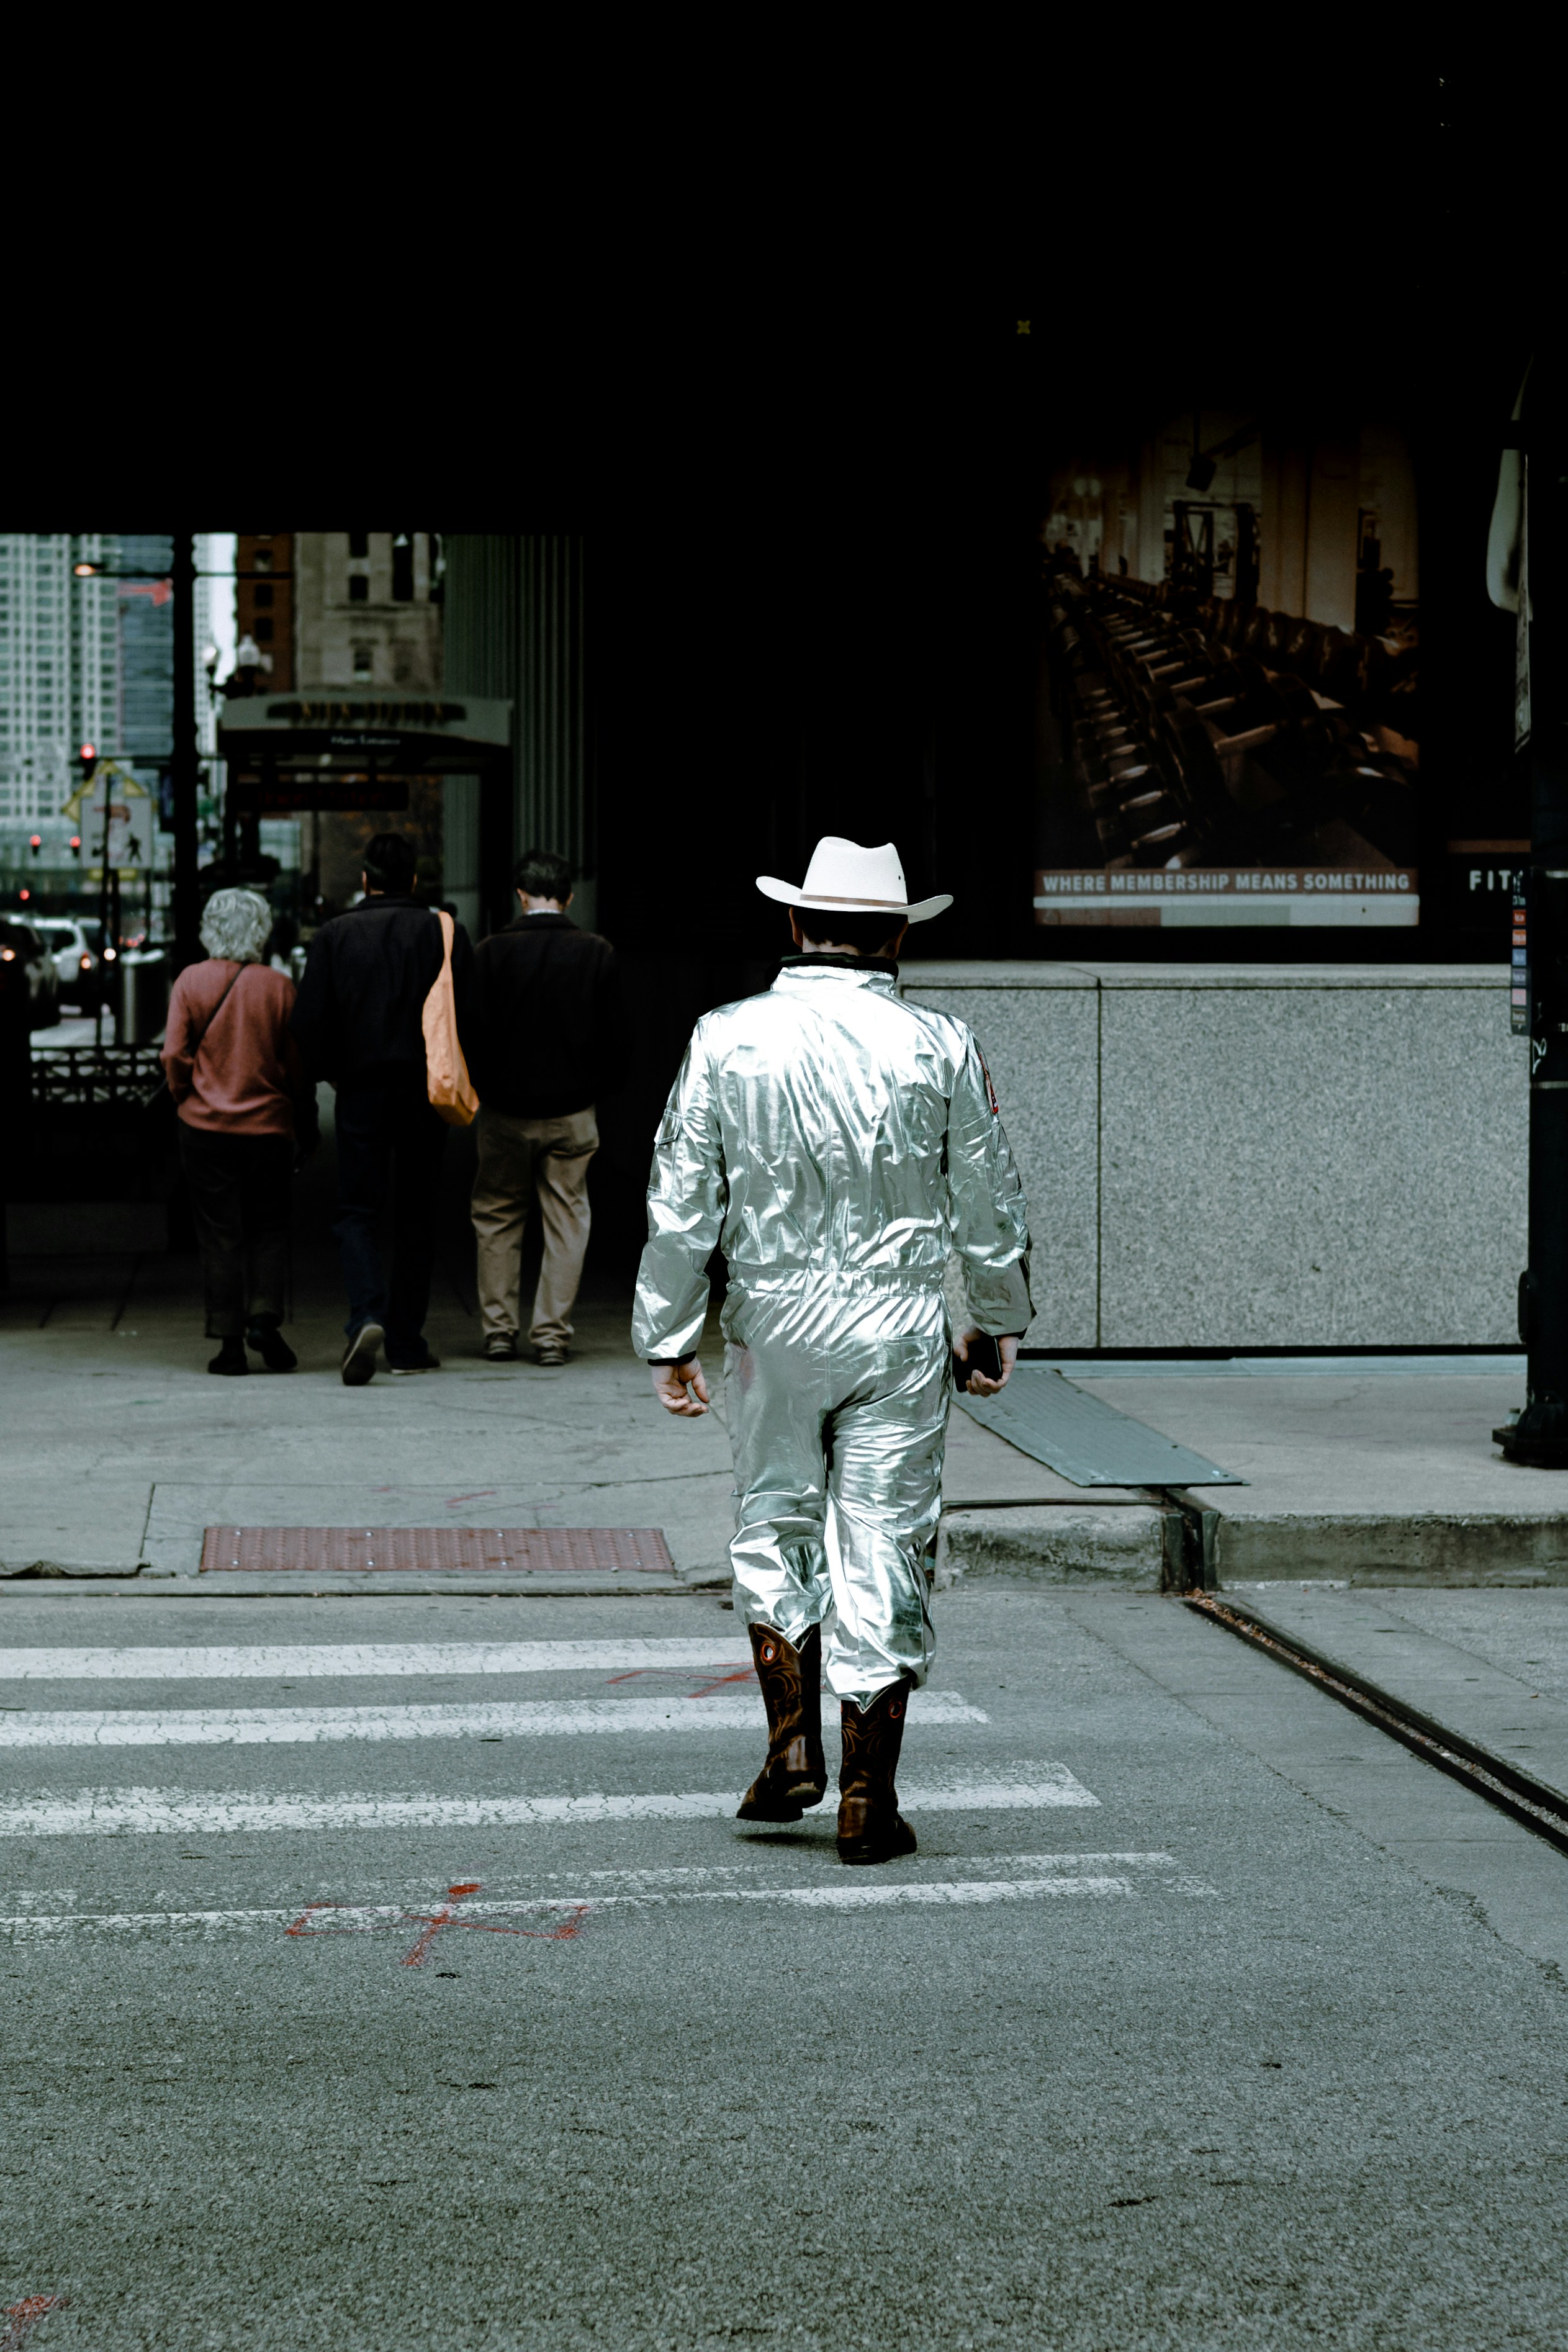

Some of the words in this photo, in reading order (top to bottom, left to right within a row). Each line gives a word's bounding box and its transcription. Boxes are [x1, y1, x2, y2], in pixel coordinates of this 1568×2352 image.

[1042, 875, 1106, 892] WHERE
[1110, 873, 1230, 891] MEMBERSHIP
[1235, 873, 1298, 890] MEANS
[1303, 873, 1410, 890] SOMETHING
